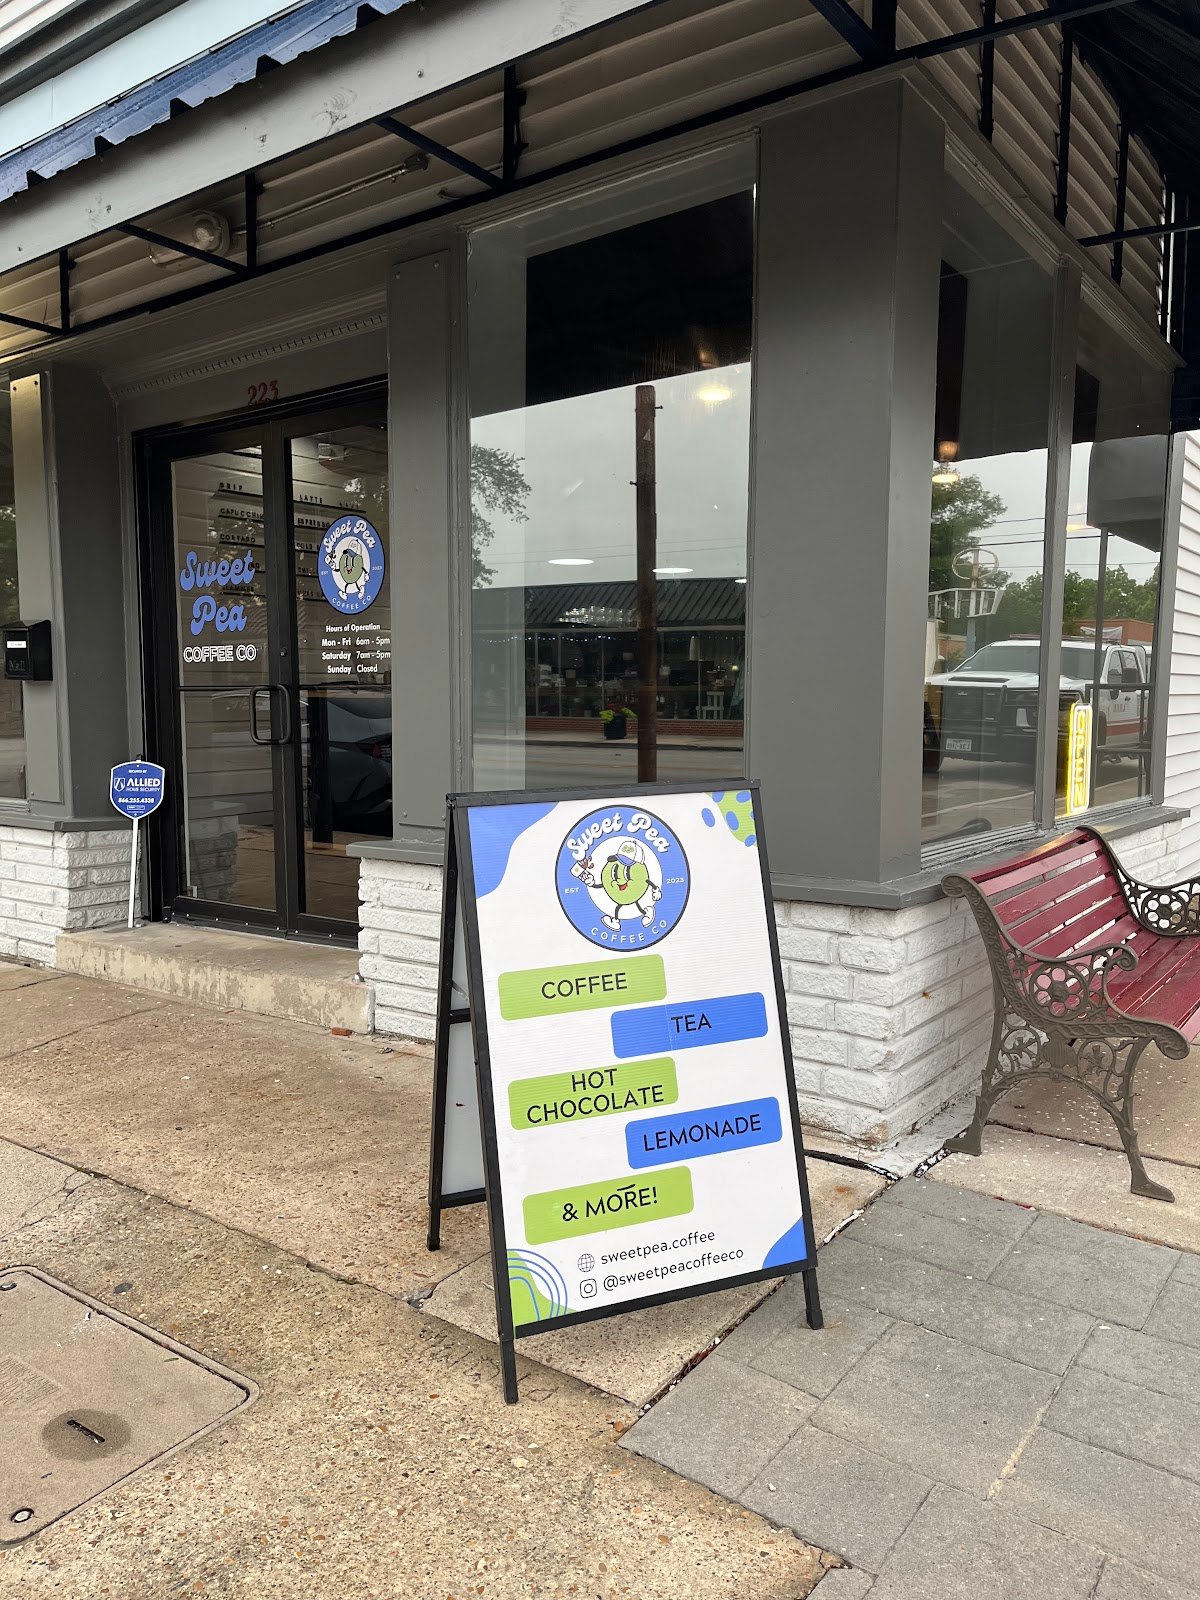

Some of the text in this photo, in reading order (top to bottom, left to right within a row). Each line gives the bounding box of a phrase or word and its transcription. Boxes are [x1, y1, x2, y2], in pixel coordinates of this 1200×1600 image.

[248, 380, 279, 406] 223
[299, 494, 323, 504] LATTE
[323, 519, 376, 553] Sweet Pea
[180, 549, 255, 592] Sweet
[332, 595, 372, 610] COFFEE CO
[190, 595, 248, 636] Pea
[325, 622, 381, 633] Hours of Operation
[183, 644, 257, 663] COFFEE CO
[321, 638, 336, 647] Mon
[342, 636, 352, 646] Fri
[355, 636, 370, 646] 6am
[375, 636, 391, 647] 5pm
[321, 650, 352, 662] Saturday
[355, 650, 371, 660] 7am
[375, 649, 391, 661] 5pm
[327, 663, 378, 675] Sunday Closed
[126, 778, 161, 787] ALLIED
[566, 812, 670, 861] Sweet Pea
[591, 920, 668, 944] COFFEE CO
[541, 972, 628, 1000] COFFEE
[671, 1013, 712, 1033] TEA
[571, 1068, 618, 1092] HOT
[527, 1084, 664, 1124] CHOCOLATE
[643, 1113, 762, 1151] LEMONADE
[562, 1185, 658, 1222] & MORE!
[600, 1230, 716, 1265] sweetpea.coffee
[603, 1249, 744, 1292] @sweetpeacoffeeco
